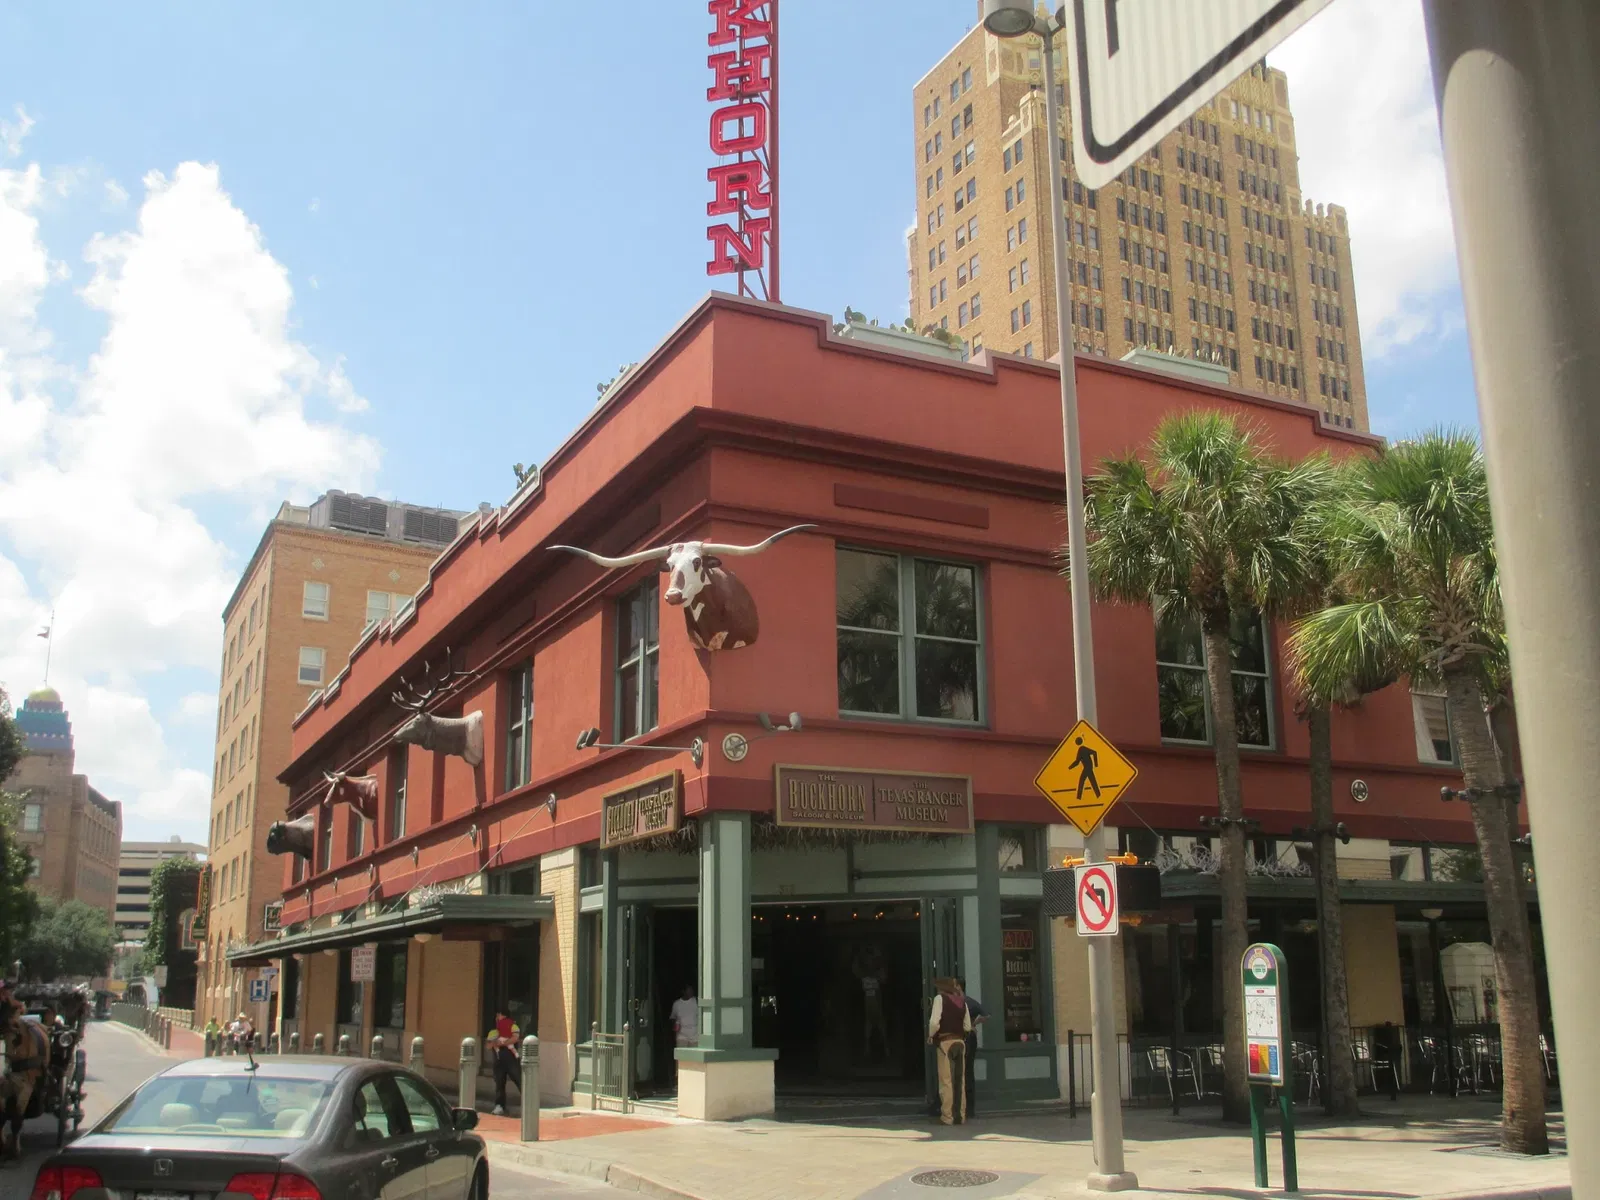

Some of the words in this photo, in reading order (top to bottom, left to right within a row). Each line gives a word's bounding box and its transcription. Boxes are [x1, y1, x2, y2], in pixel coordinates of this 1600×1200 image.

[707, 0, 772, 276] KHORN
[818, 774, 836, 782] THE
[788, 779, 866, 811] BUCKHORN
[878, 788, 914, 803] TEXAS
[917, 790, 963, 807] RANGER
[897, 806, 948, 822] MUSEUM
